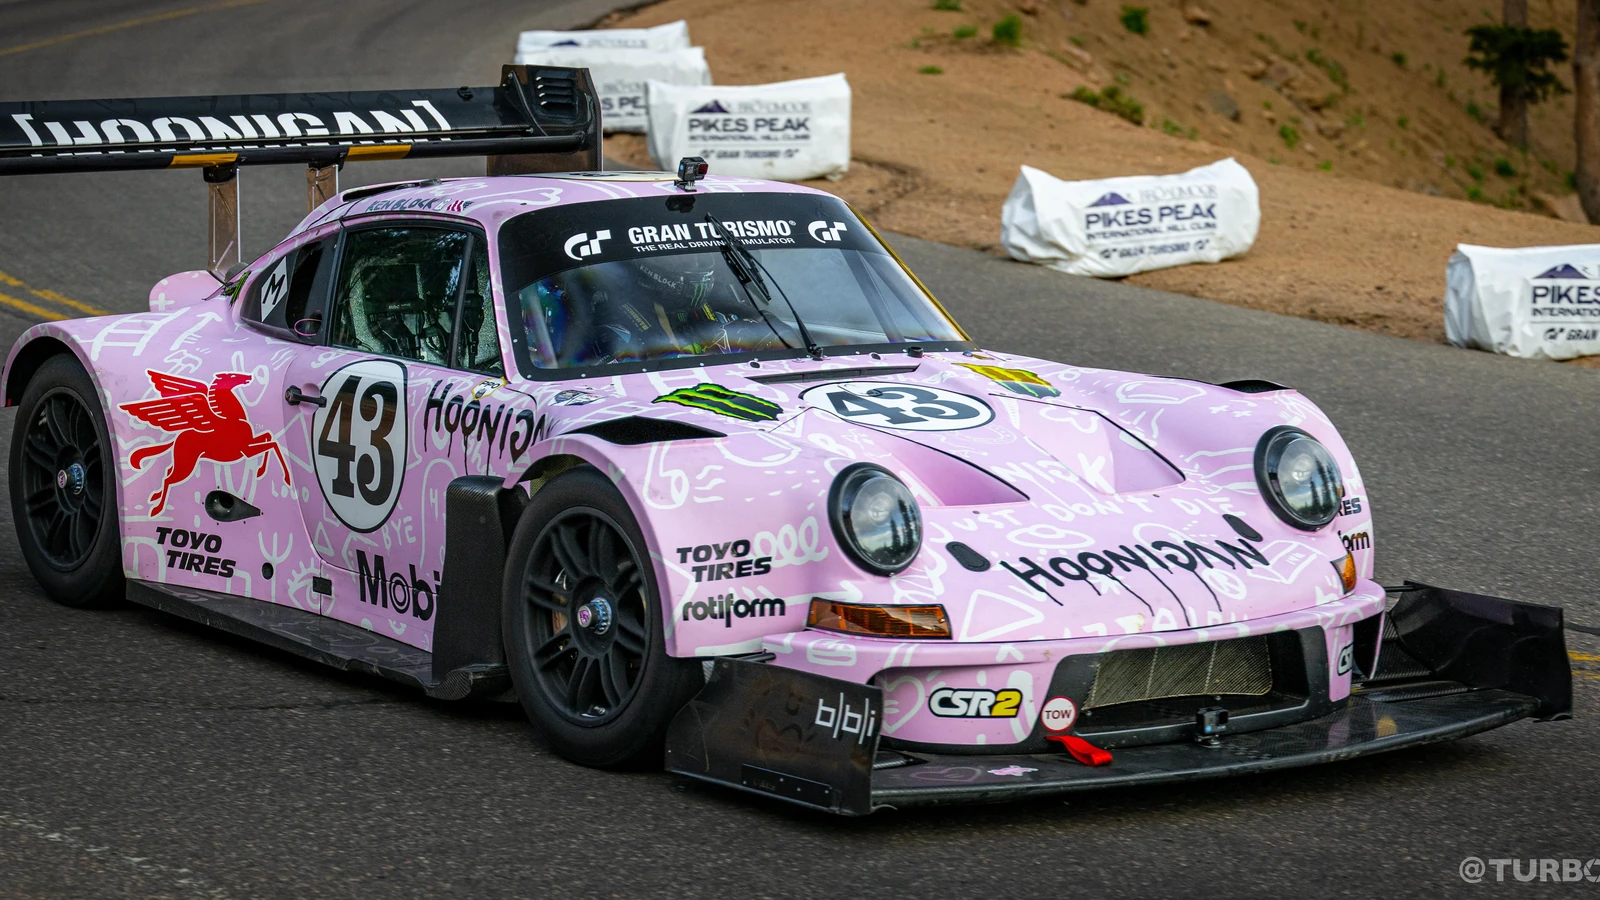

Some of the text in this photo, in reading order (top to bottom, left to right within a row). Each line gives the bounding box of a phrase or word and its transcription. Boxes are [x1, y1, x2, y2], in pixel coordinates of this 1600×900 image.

[688, 117, 811, 132] PIKES PEAK
[365, 198, 440, 213] KEN BLOCK
[1085, 203, 1217, 229] PIKES PEAK
[628, 223, 692, 245] GRAN
[633, 237, 795, 253] THE REAL DRIVIN IMULATOR
[832, 386, 980, 425] 43
[317, 375, 398, 507] 43
[381, 516, 417, 550] BYE
[929, 509, 1022, 543] JUST
[1171, 496, 1247, 517] DIE
[156, 526, 222, 553] TOYO
[676, 539, 751, 564] TOYO
[167, 549, 236, 578] TIRES
[692, 556, 772, 582] TIRES
[356, 549, 441, 621] Mobi
[682, 593, 786, 628] rotiform
[929, 689, 1020, 717] CSR2
[1045, 710, 1072, 720] TOW
